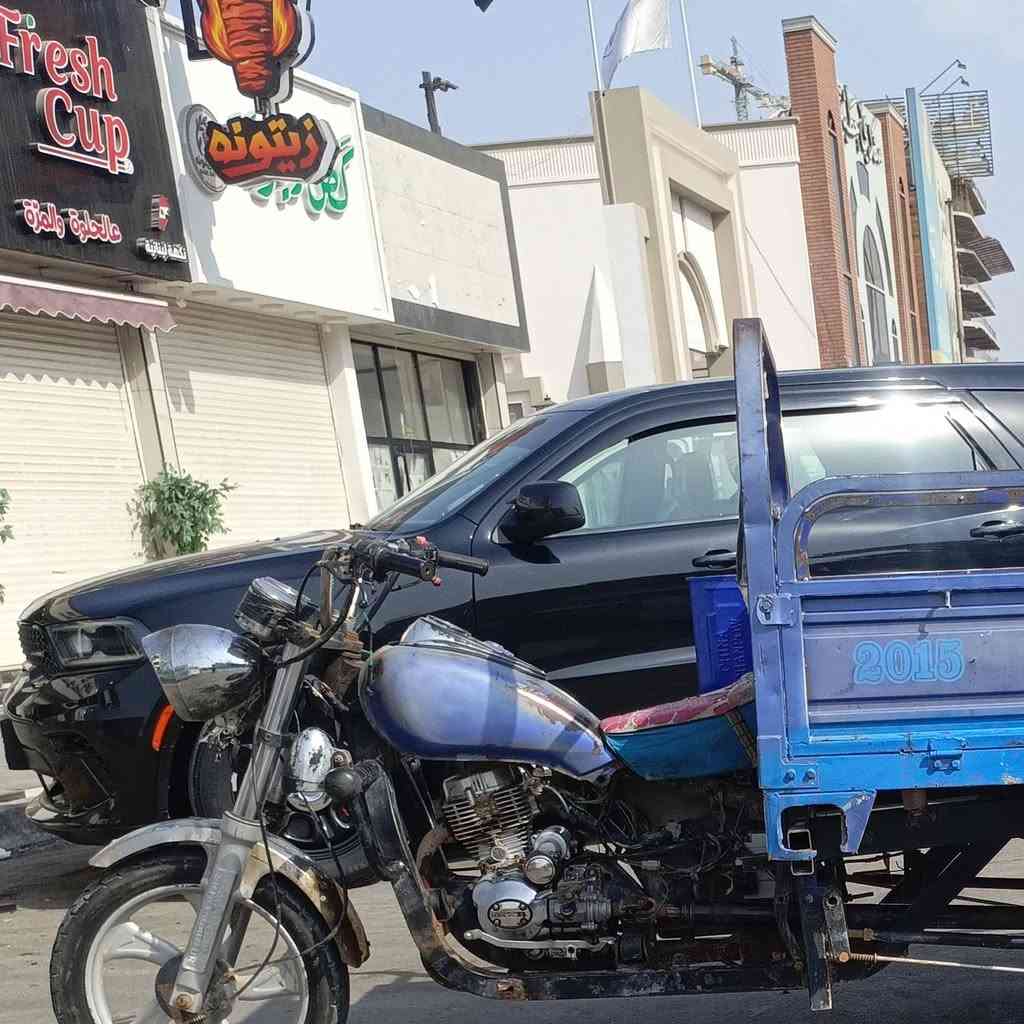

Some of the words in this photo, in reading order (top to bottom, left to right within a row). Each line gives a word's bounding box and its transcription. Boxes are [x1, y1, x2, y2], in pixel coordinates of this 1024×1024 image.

[0, 5, 118, 102] Fresh
[43, 87, 131, 175] Cup
[854, 639, 965, 684] 2015
